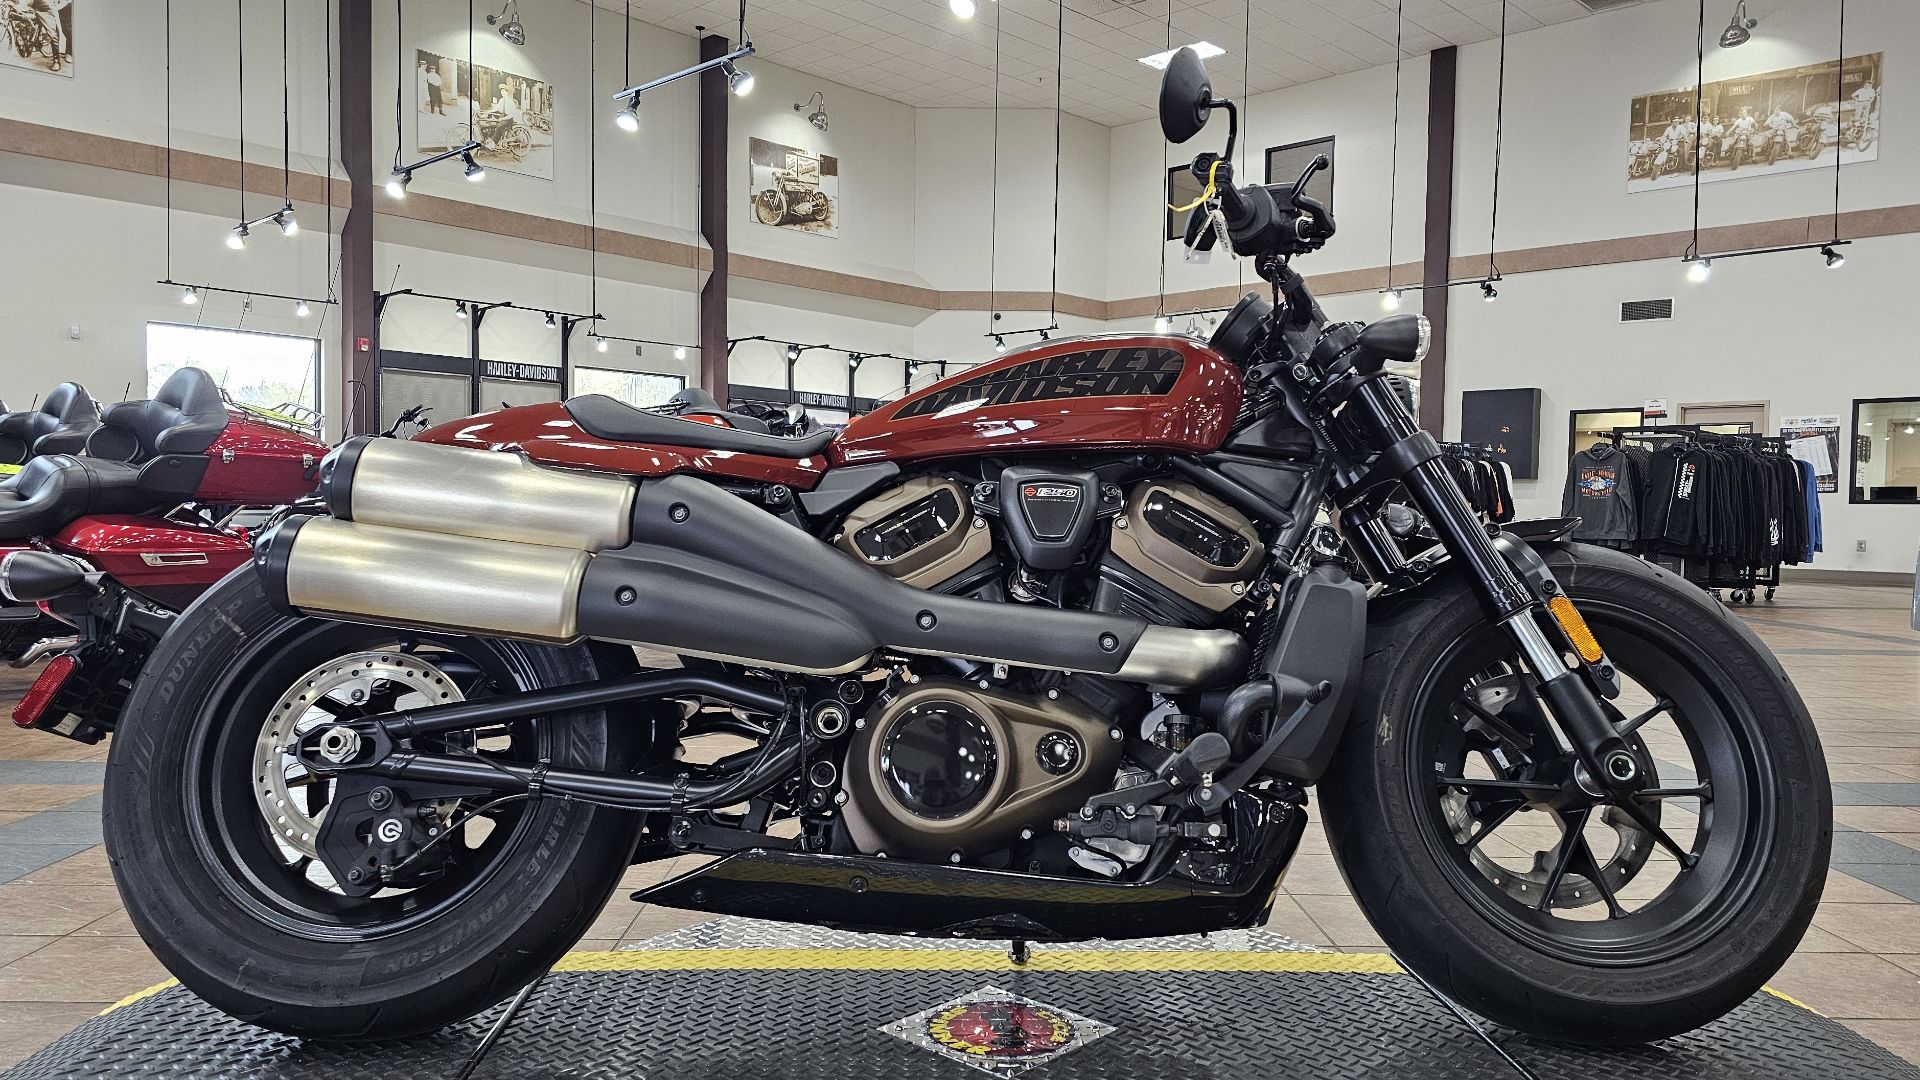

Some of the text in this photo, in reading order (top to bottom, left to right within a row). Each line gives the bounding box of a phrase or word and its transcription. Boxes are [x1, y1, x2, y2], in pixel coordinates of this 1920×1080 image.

[487, 361, 557, 381] HARLEY-DAVIDSON
[960, 347, 1183, 386] HARLEY
[799, 392, 848, 408] HARLEY-DAVIDSON
